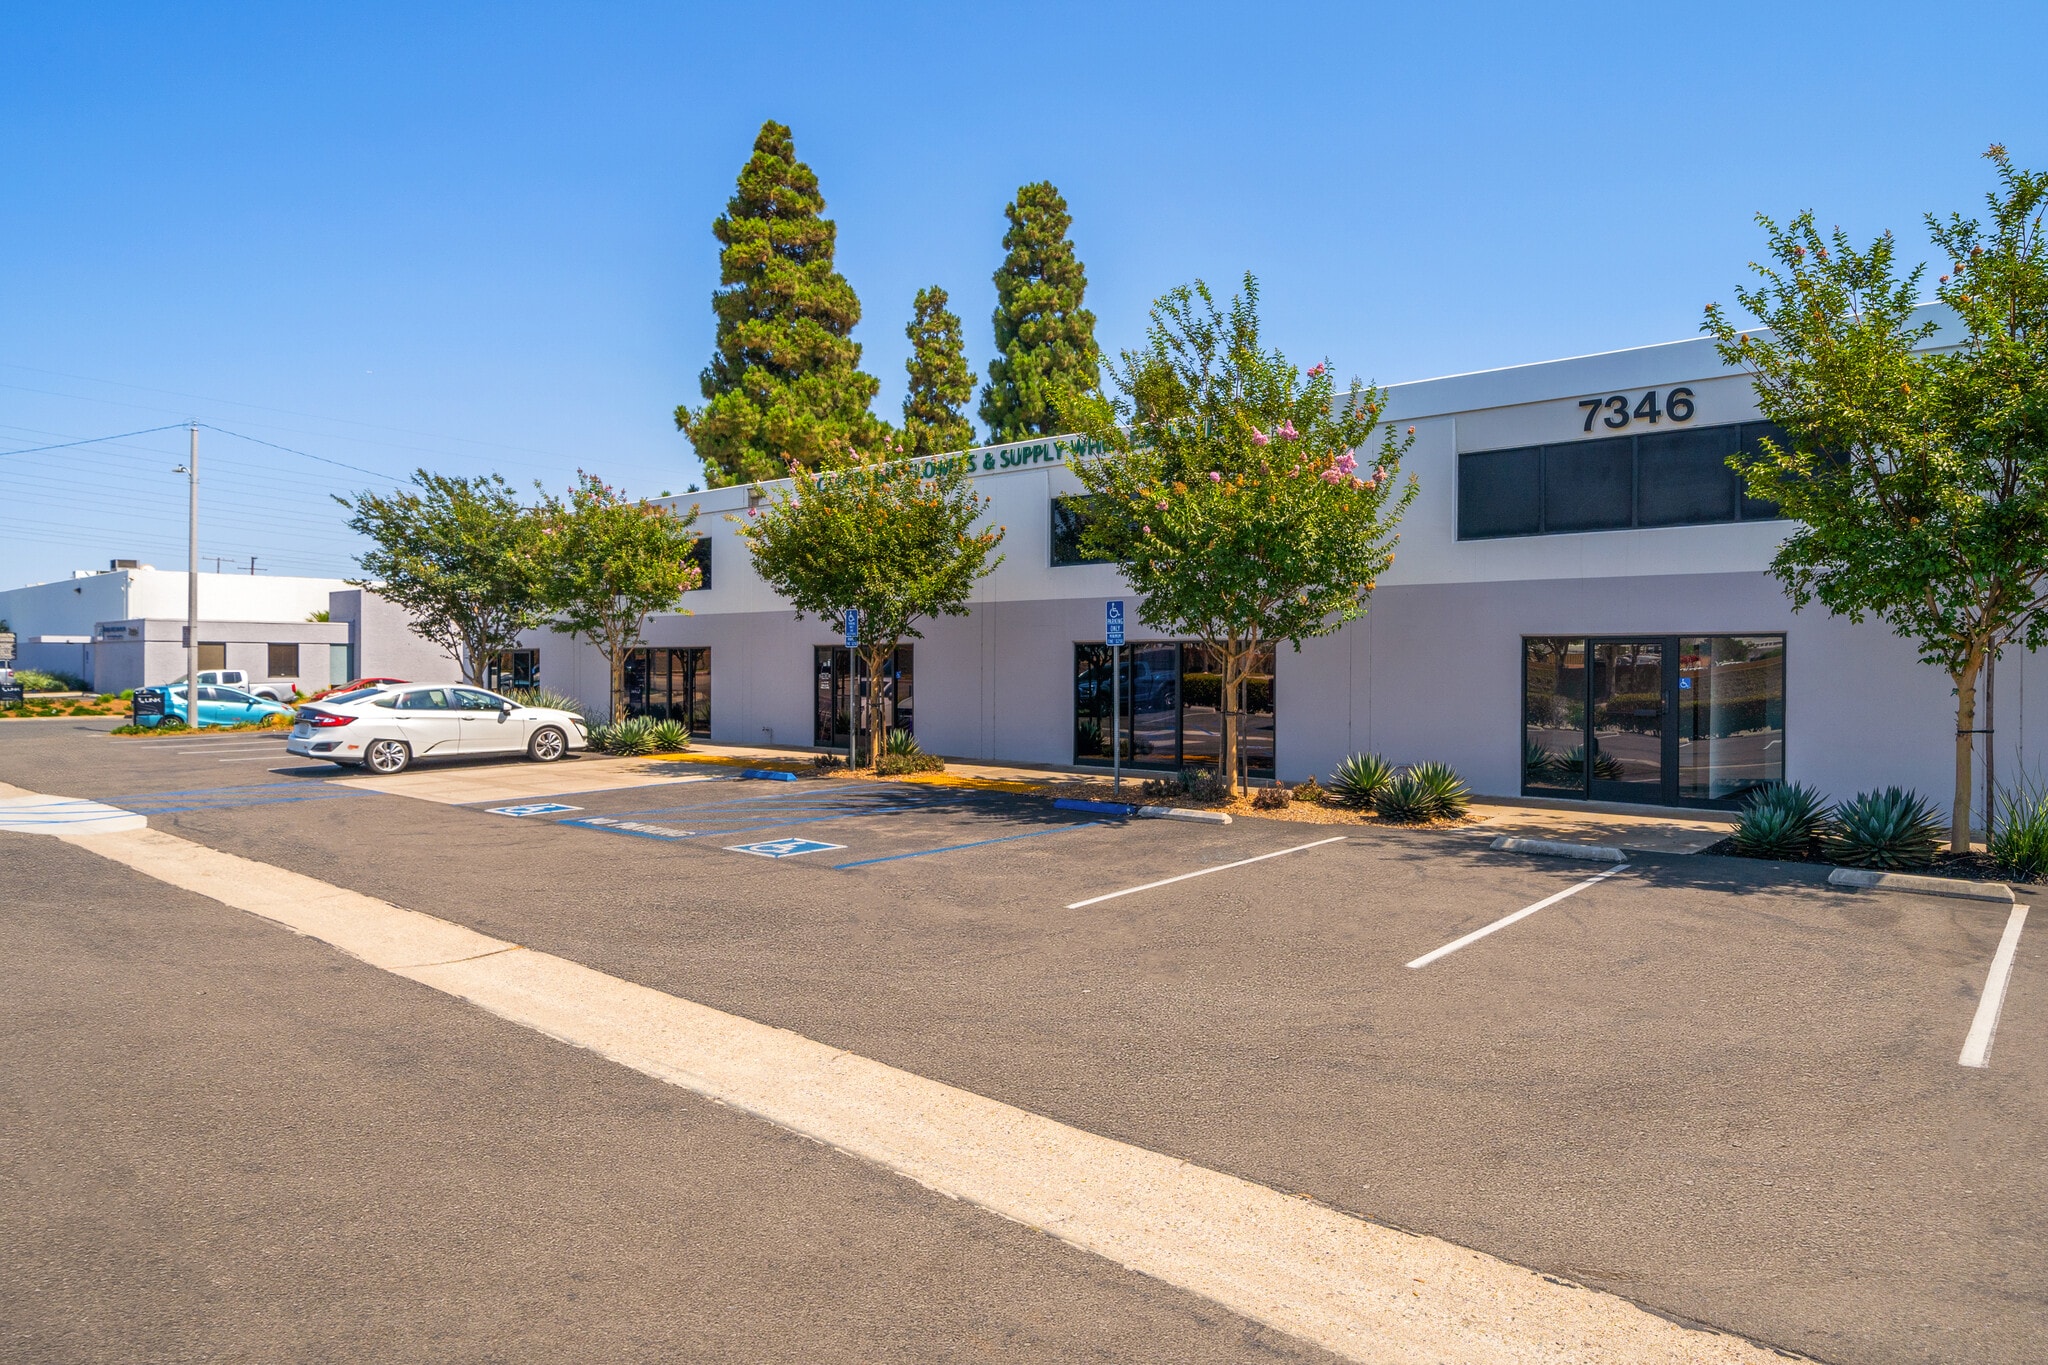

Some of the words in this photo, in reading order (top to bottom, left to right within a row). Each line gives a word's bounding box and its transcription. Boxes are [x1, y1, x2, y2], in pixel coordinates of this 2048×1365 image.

[1578, 387, 1695, 432] 7346
[908, 454, 977, 481] LOWS
[983, 452, 996, 471] &
[1000, 440, 1065, 468] SUPPLY
